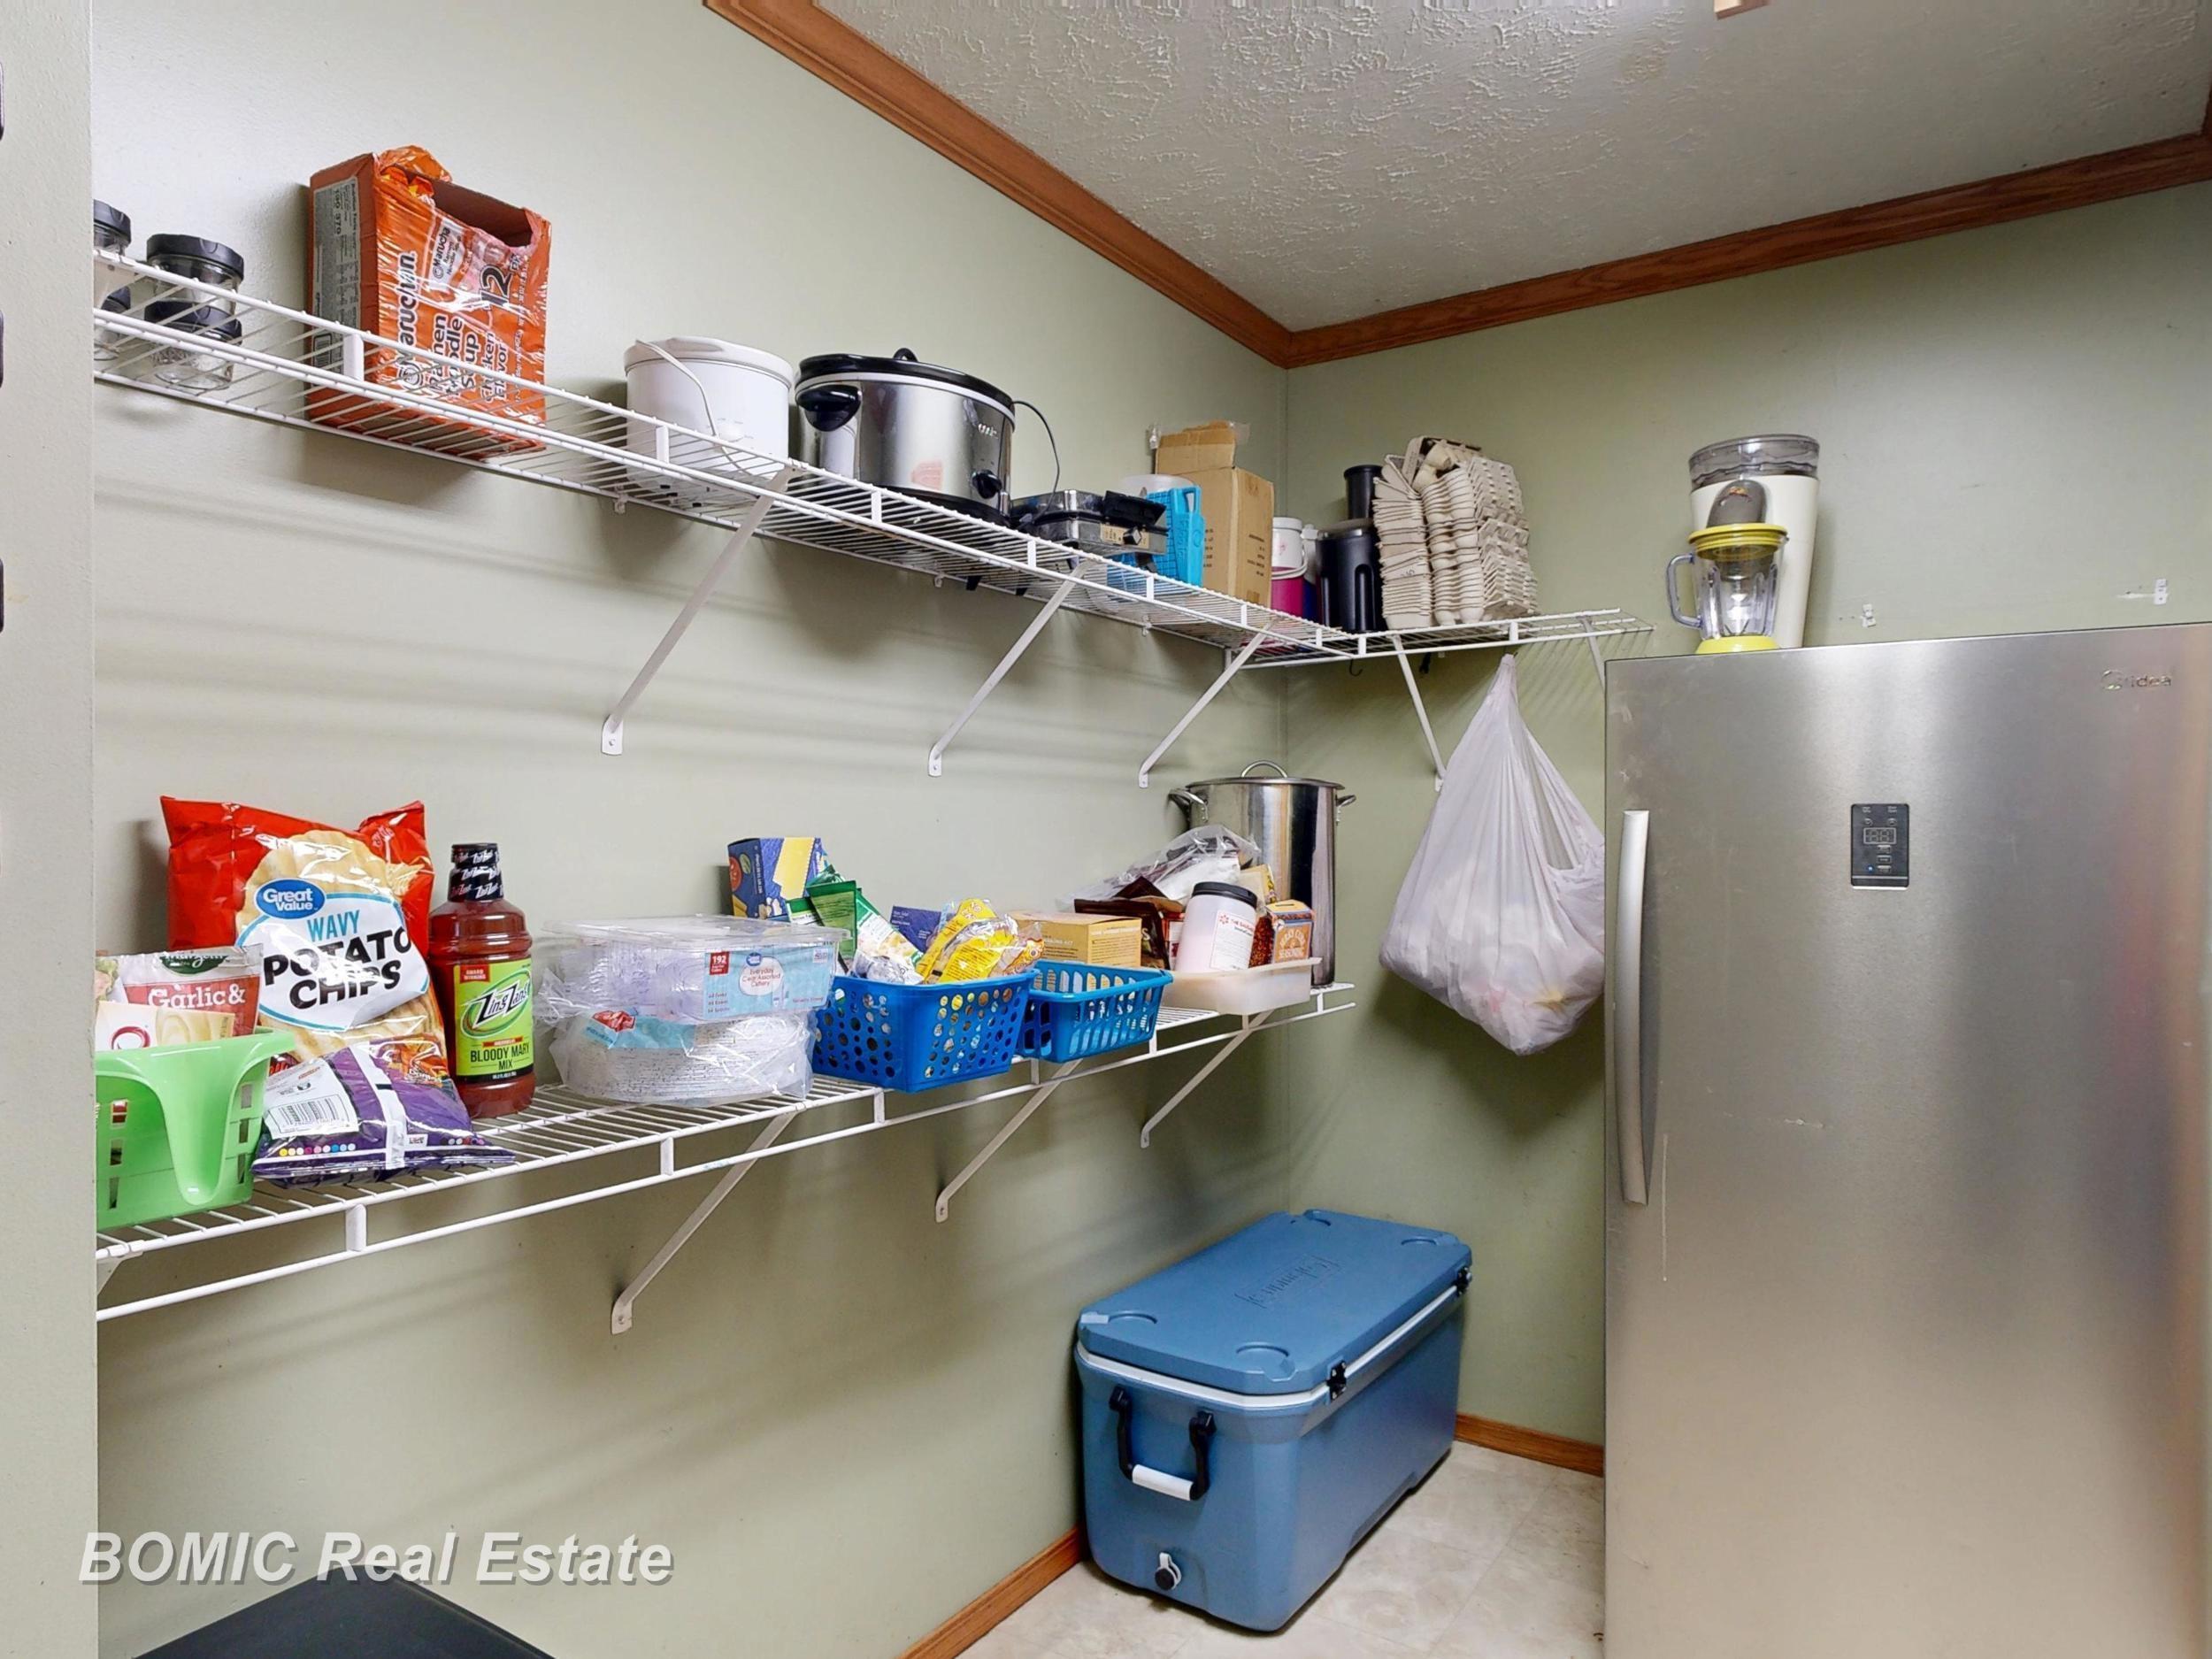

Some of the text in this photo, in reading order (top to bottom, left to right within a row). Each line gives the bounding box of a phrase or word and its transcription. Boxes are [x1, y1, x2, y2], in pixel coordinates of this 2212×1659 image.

[263, 887, 313, 902] Great
[275, 900, 313, 912] Value
[306, 910, 360, 942] WAVY
[712, 955, 727, 964] 192
[289, 959, 401, 1010] CHIPS
[149, 983, 246, 1009] Garlic &
[470, 1046, 511, 1063] BLOODY
[511, 1041, 530, 1057] MARY
[498, 1059, 513, 1071] MIX
